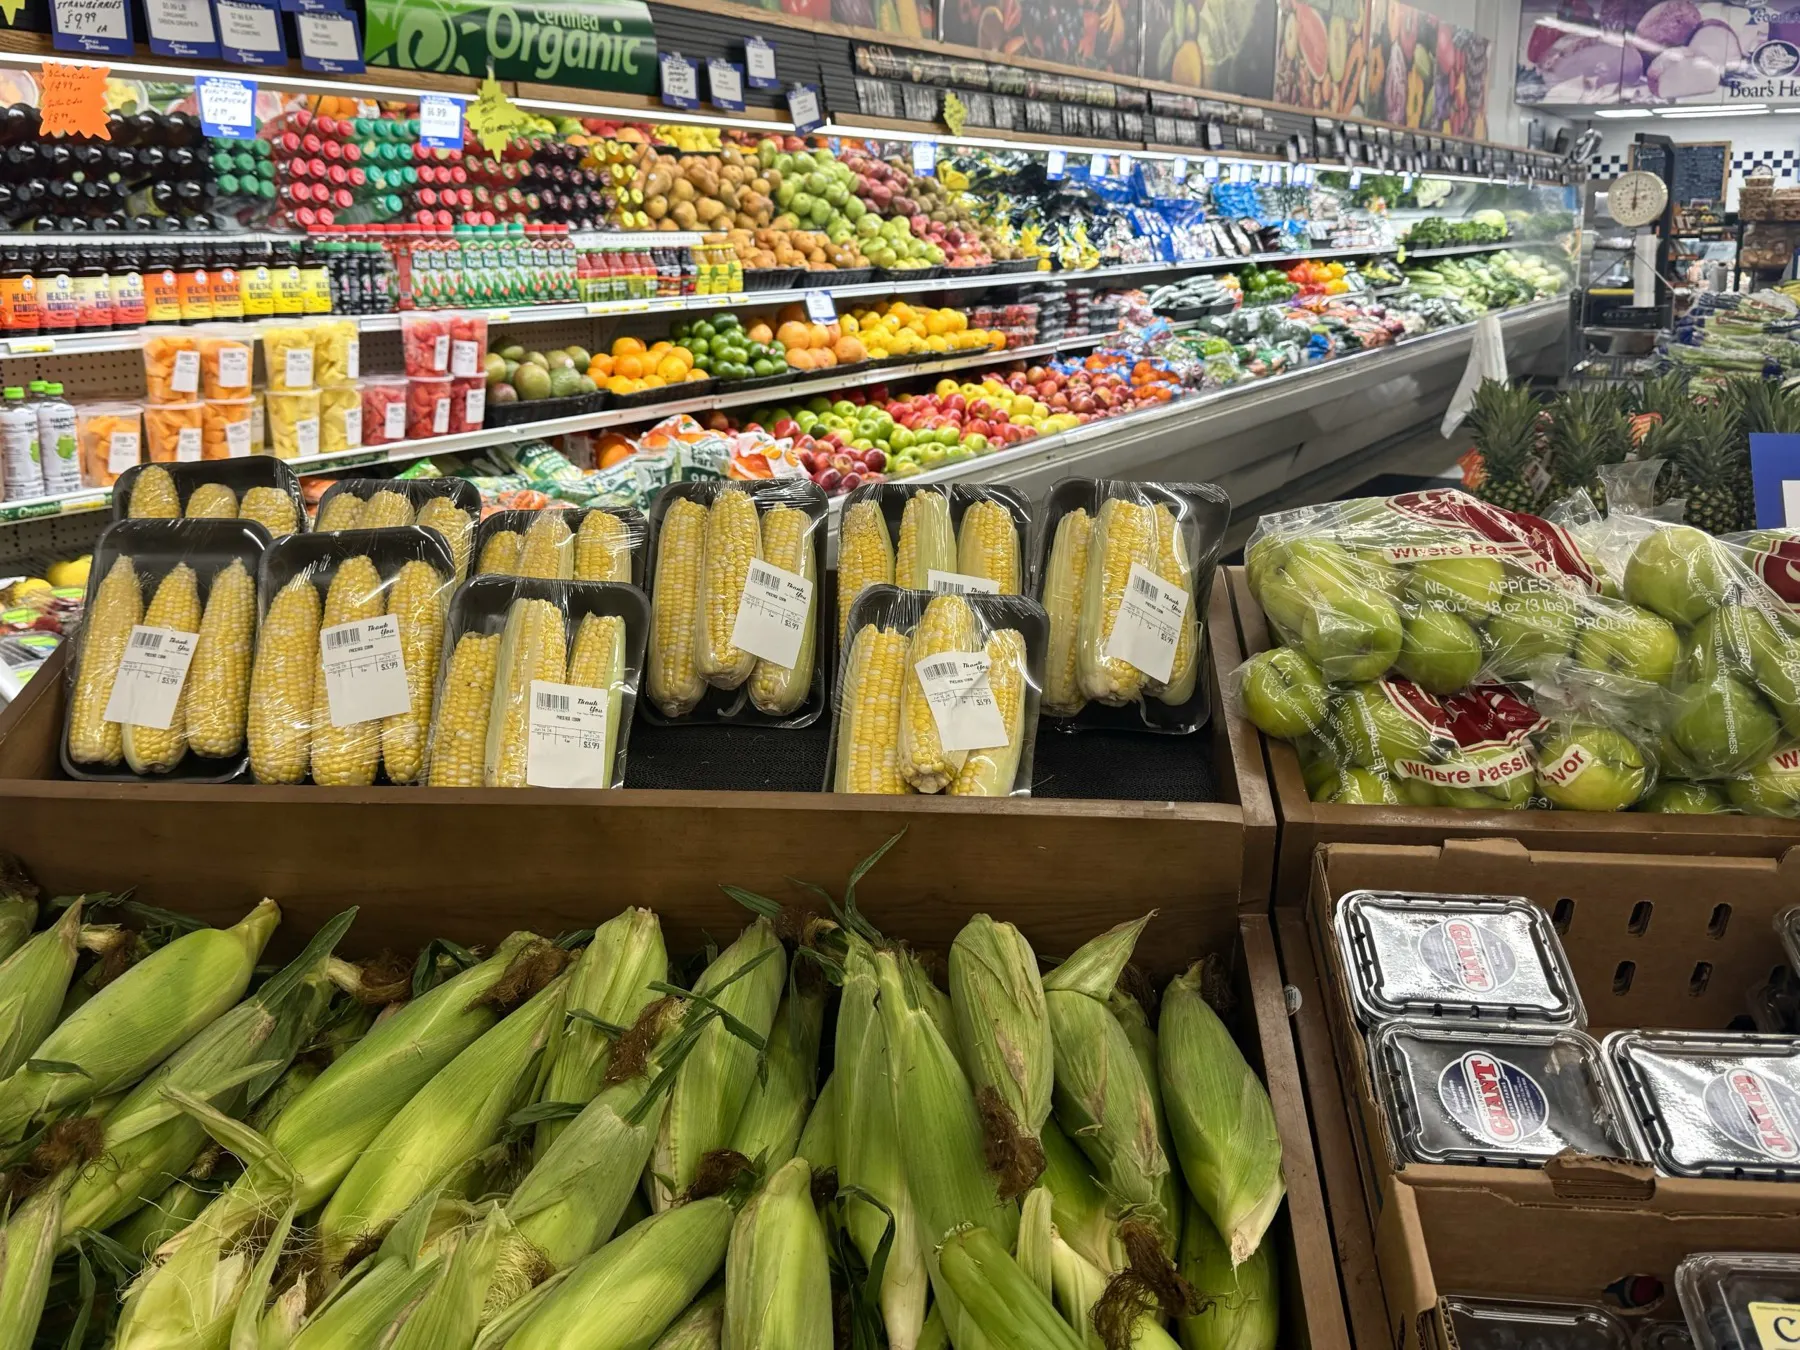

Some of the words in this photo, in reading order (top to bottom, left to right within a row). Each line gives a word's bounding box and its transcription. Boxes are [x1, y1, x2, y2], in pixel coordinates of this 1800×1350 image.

[534, 7, 600, 31] Certified
[486, 4, 641, 79] Organic
[1730, 80, 1774, 98] Boar's
[1392, 544, 1463, 559] Where
[787, 582, 804, 593] Thank
[1487, 579, 1551, 596] APPLES
[796, 592, 807, 600] You
[1163, 592, 1180, 606] Thank
[1171, 604, 1182, 614] You
[1504, 602, 1523, 613] oz
[368, 622, 389, 632] Thank
[380, 628, 394, 636] You
[169, 637, 188, 645] Thank
[177, 644, 190, 652] You
[963, 660, 983, 669] Thank
[577, 698, 598, 706] Thank
[589, 706, 603, 714] You
[1724, 709, 1738, 755] FRESHNESS
[1400, 760, 1472, 784] Where
[1448, 923, 1490, 987] GIANT
[1471, 1060, 1516, 1137] GIANT
[1732, 1074, 1793, 1153] GIANT
